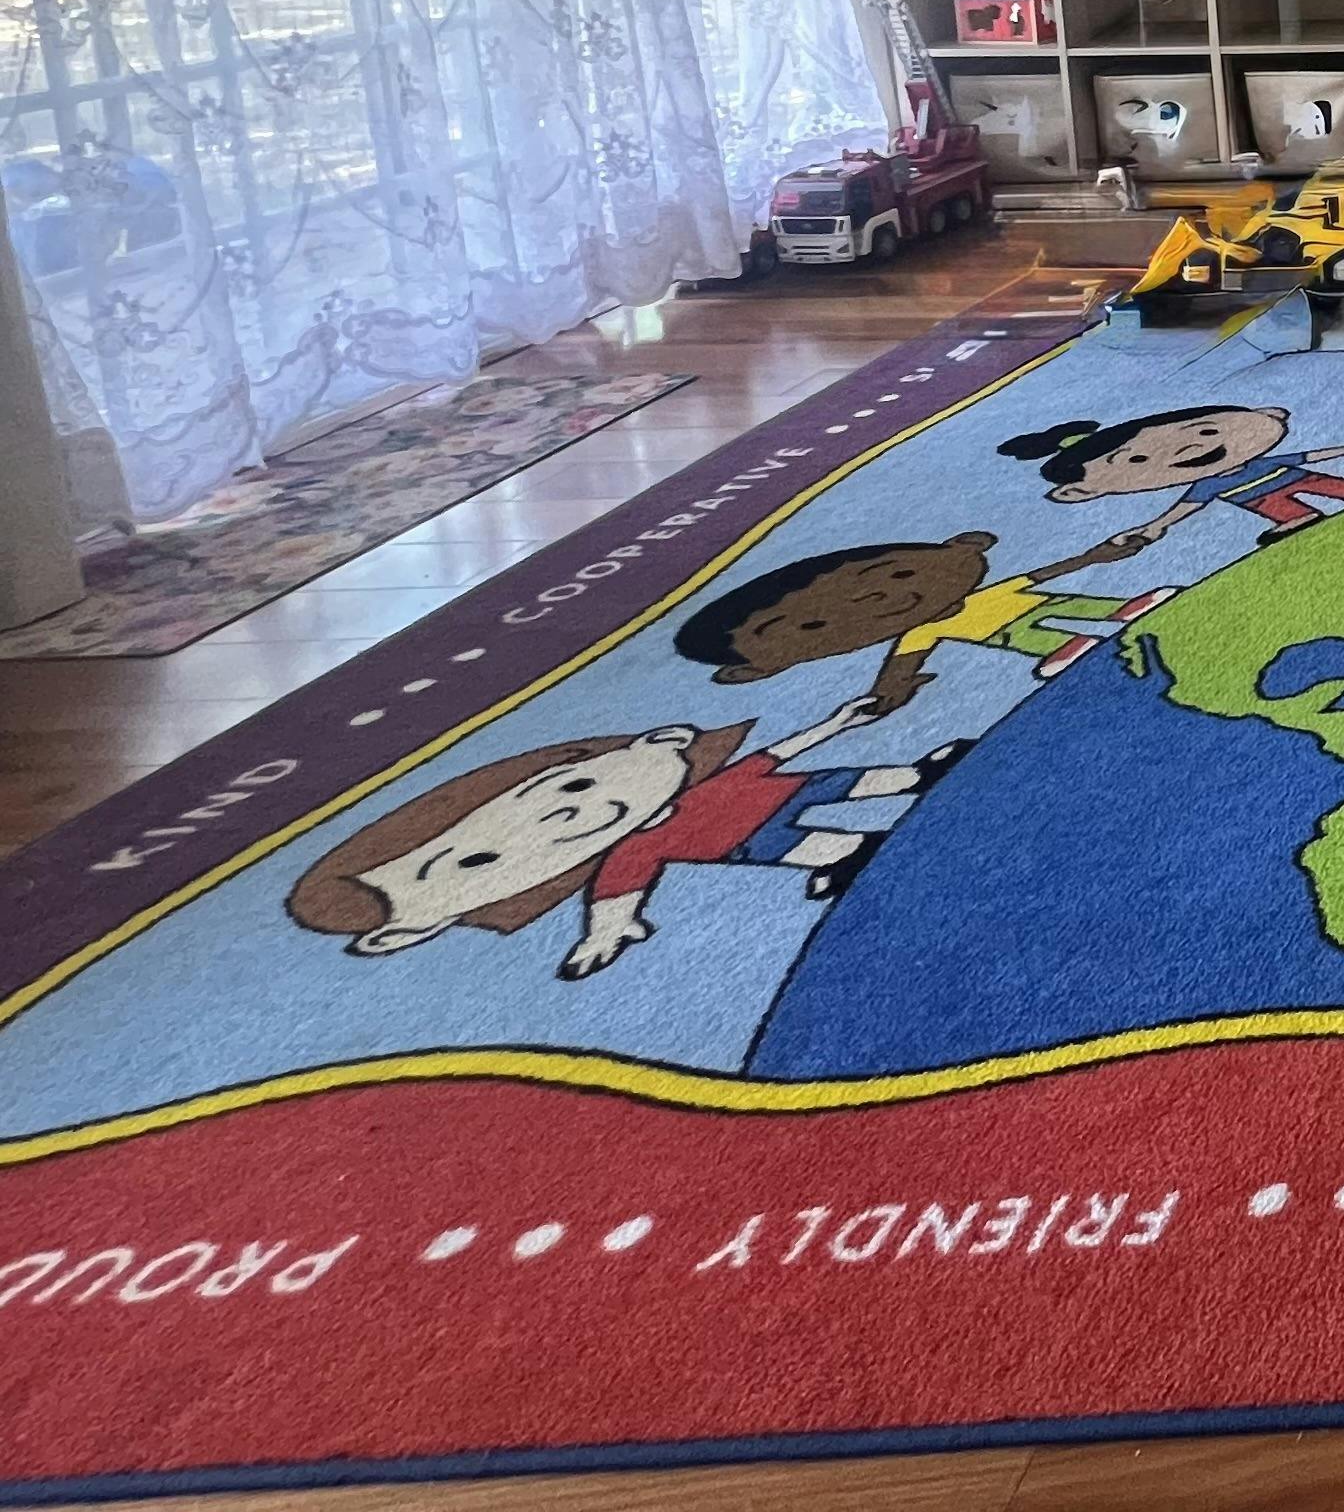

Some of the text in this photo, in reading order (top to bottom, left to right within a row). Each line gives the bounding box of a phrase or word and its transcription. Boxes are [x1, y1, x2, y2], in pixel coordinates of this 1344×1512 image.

[90, 447, 814, 871] KIND COOPERATIVE
[695, 1188, 1180, 1271] FRIENDLY
